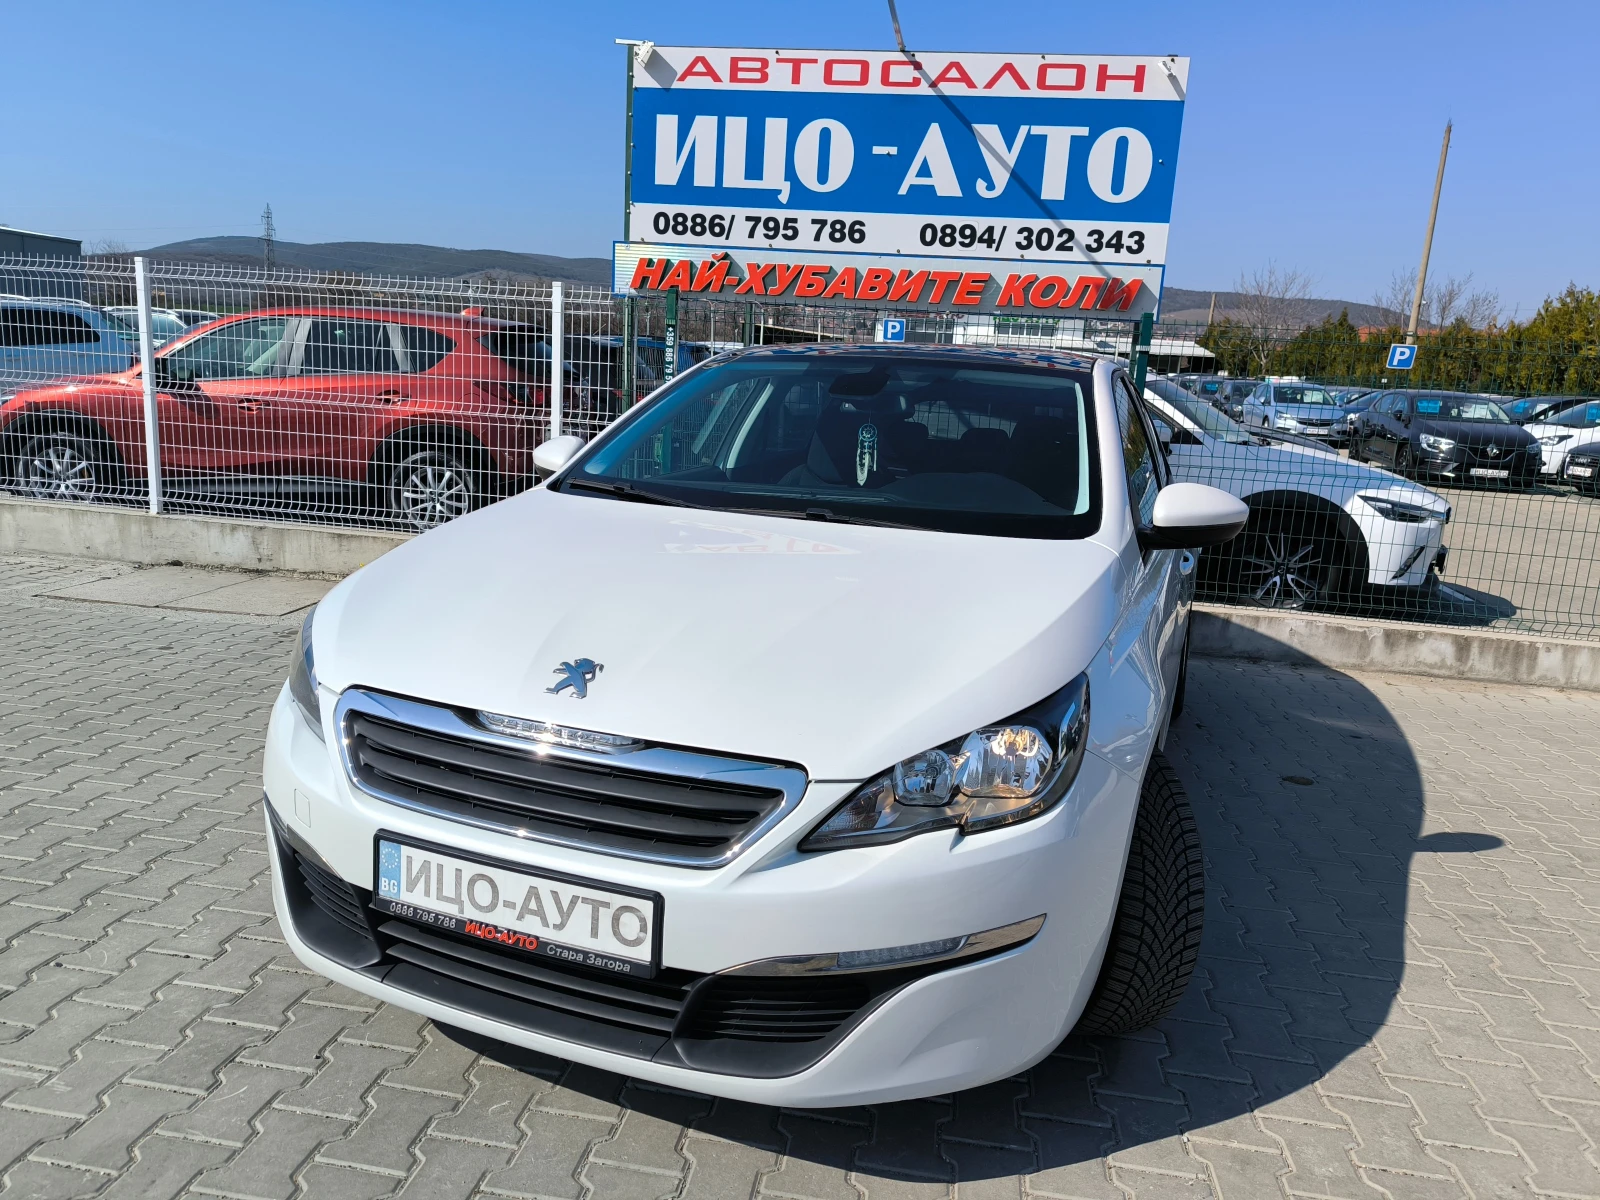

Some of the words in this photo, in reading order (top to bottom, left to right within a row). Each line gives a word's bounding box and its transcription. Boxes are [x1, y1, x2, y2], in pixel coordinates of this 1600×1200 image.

[676, 55, 1146, 93] АВТОСАЛОН
[652, 211, 735, 241] 0886/
[746, 215, 800, 242] 795
[810, 219, 867, 244] 786
[918, 223, 1007, 251] 0894/
[1015, 227, 1075, 253] 302
[1085, 231, 1146, 255] 343
[629, 252, 988, 306] НАЙ-ХУБАВИТЕ
[996, 273, 1144, 312] КОЛИ
[887, 322, 900, 338] P
[665, 347, 674, 362] 886
[665, 364, 673, 373] 79
[1392, 347, 1410, 366] P
[381, 877, 398, 893] BG
[405, 855, 648, 948] ИЦО-АУТО
[389, 902, 414, 917] 0886
[416, 909, 436, 922] 795
[437, 914, 456, 929] 786
[464, 920, 539, 950] ИЦО-АУТО
[547, 944, 584, 962] Стара
[586, 954, 631, 973] Загора
